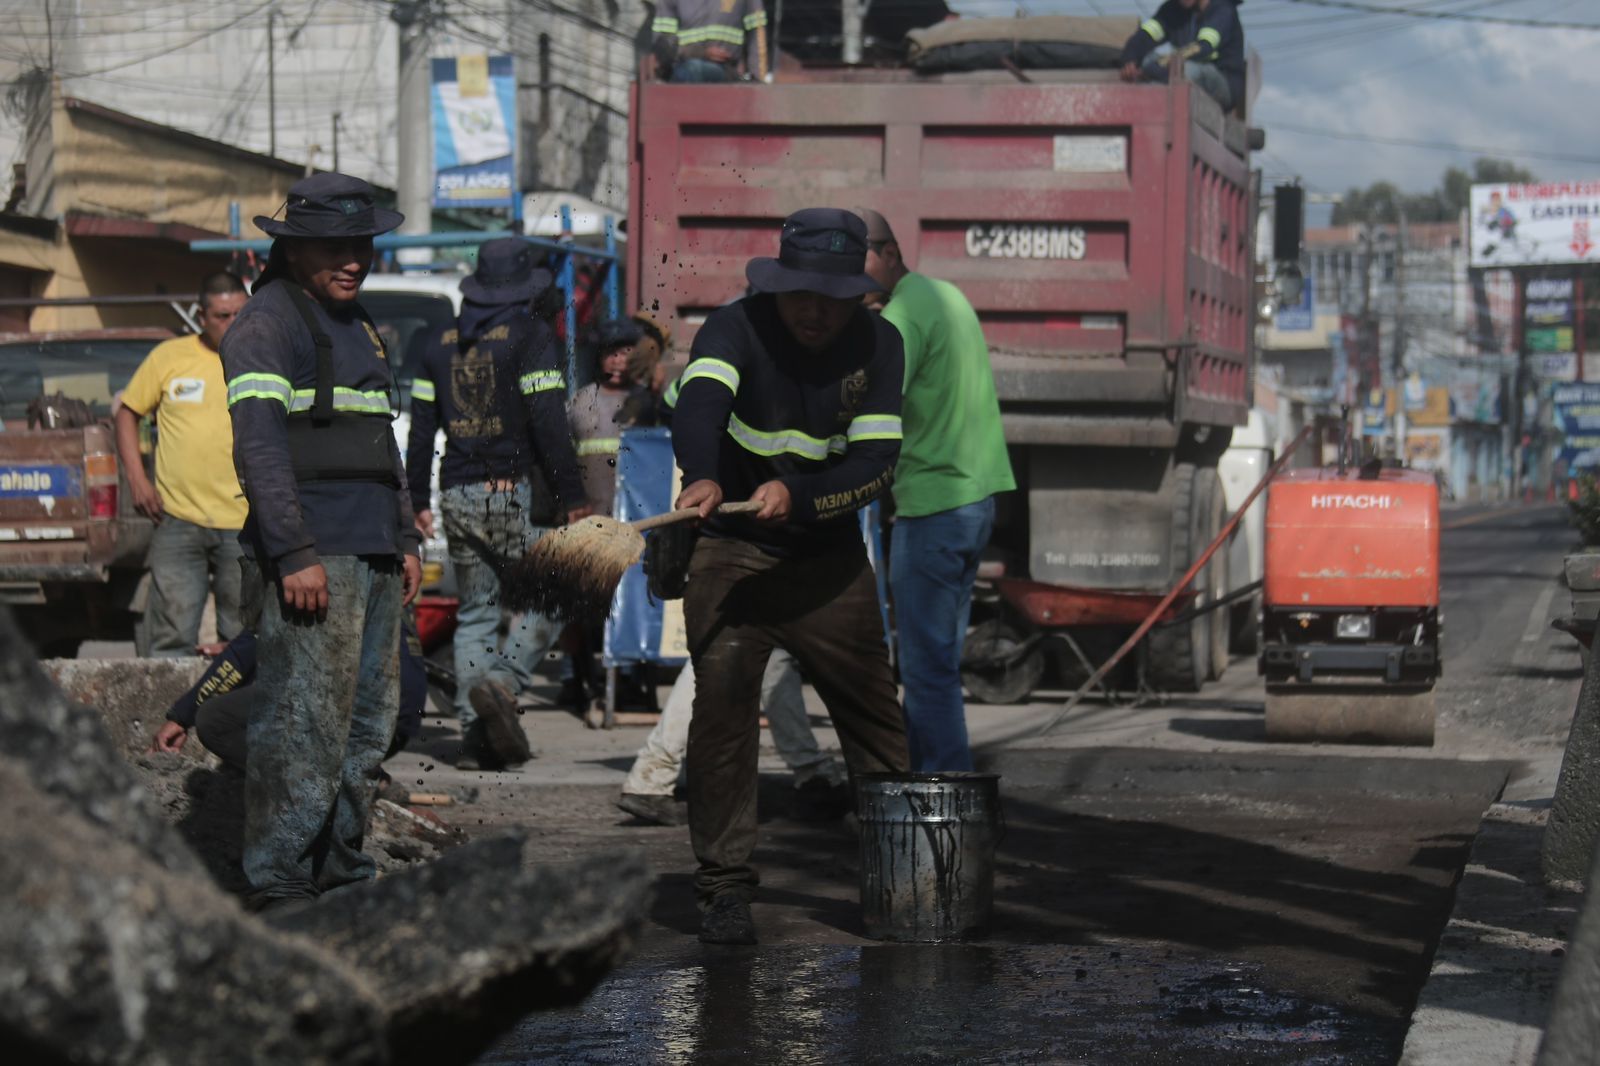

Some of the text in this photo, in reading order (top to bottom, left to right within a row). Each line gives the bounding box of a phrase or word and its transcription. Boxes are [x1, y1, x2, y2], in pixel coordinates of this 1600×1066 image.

[965, 224, 1086, 260] C-238BMS
[813, 490, 853, 511] NUEVA
[1311, 494, 1391, 509] HITACHI
